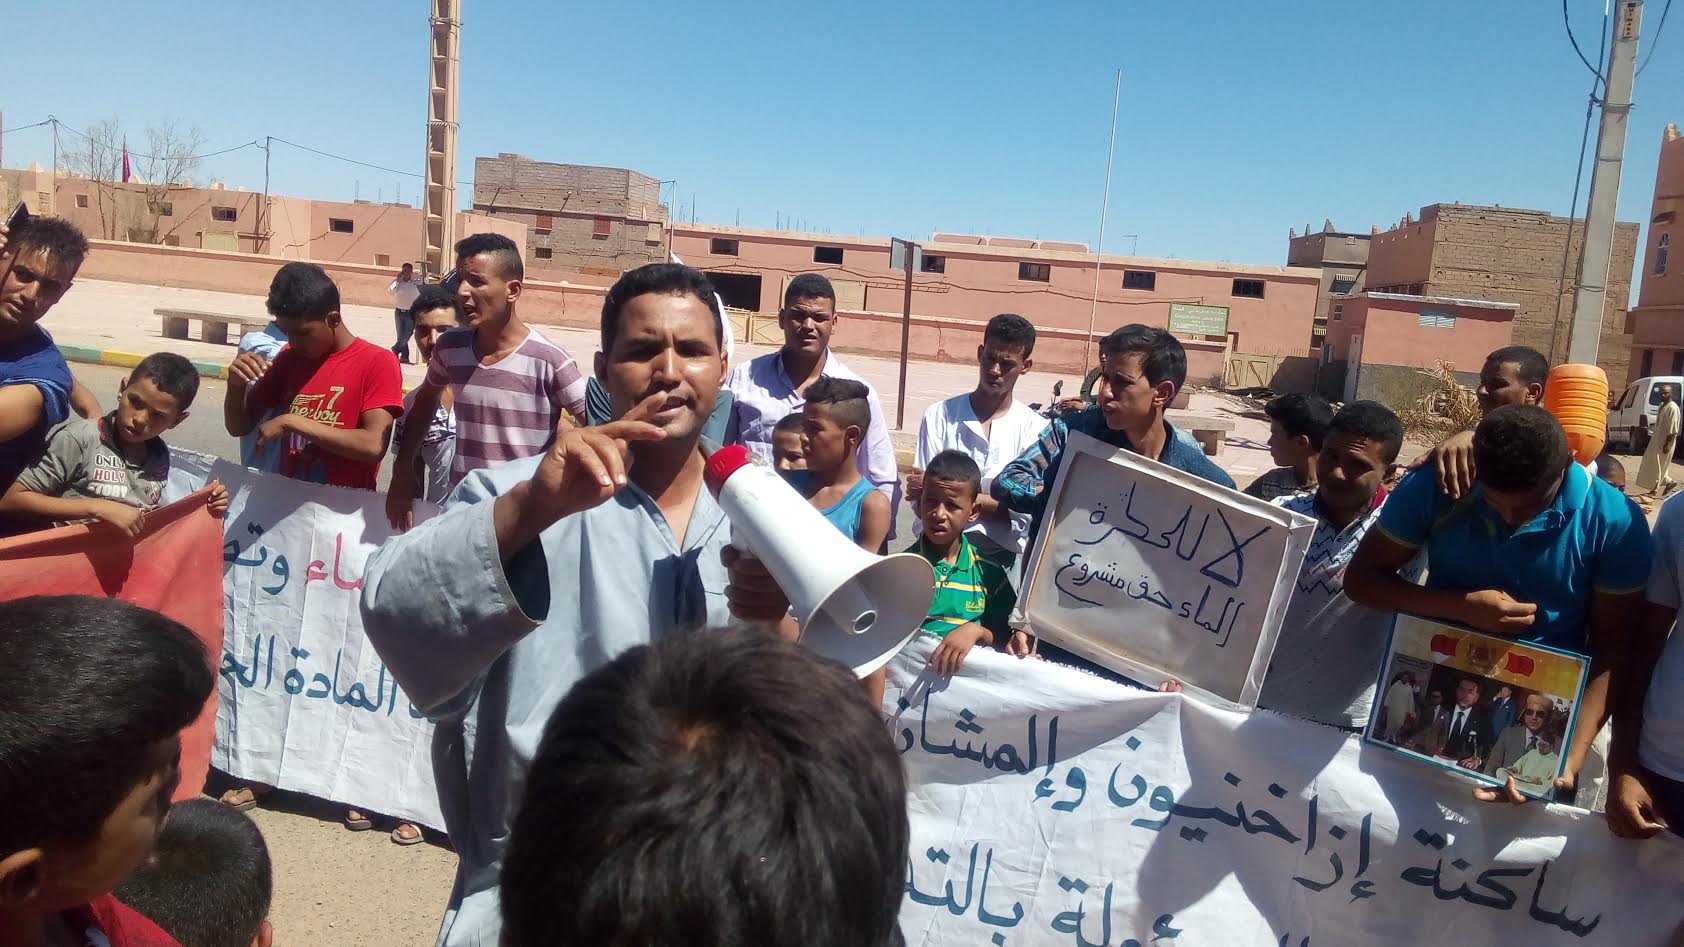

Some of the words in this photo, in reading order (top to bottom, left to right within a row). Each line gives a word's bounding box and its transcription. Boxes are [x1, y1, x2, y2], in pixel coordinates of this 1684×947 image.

[329, 386, 345, 410] 7
[93, 468, 126, 484] HOLY
[95, 453, 126, 470] ONLY
[1200, 508, 1271, 588] لا
[1054, 553, 1126, 608] مشروع
[1126, 574, 1174, 611] حق
[1178, 585, 1245, 648] الماء
[284, 645, 398, 719] المادة
[1400, 827, 1603, 939] ساكنة
